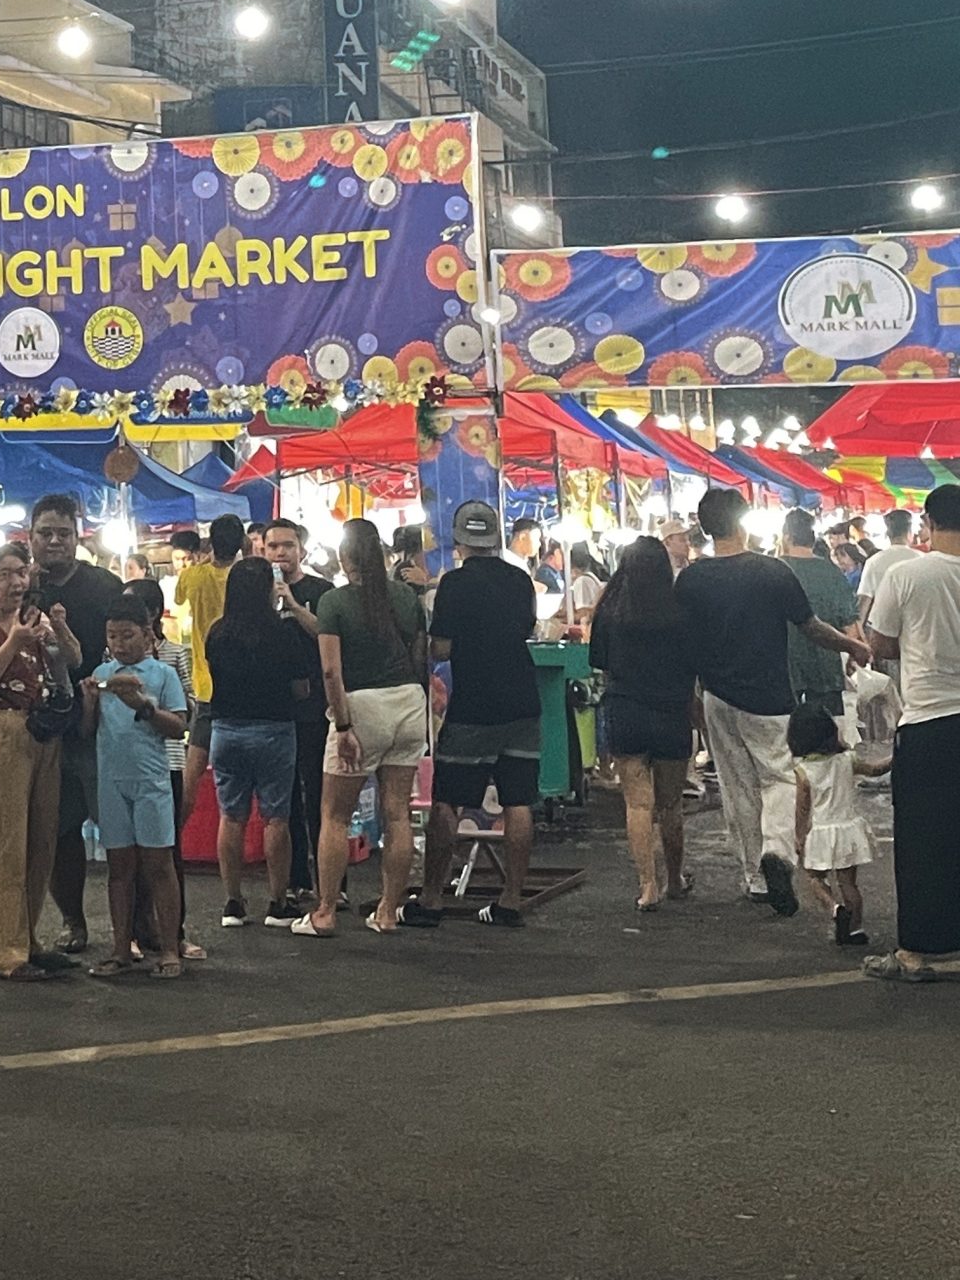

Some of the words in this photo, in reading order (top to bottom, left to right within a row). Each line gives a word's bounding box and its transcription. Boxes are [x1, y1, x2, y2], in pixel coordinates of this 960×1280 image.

[140, 229, 391, 290] MARKET
[800, 321, 851, 333] MARK
[855, 319, 902, 330] MALL
[3, 353, 29, 361] MARK
